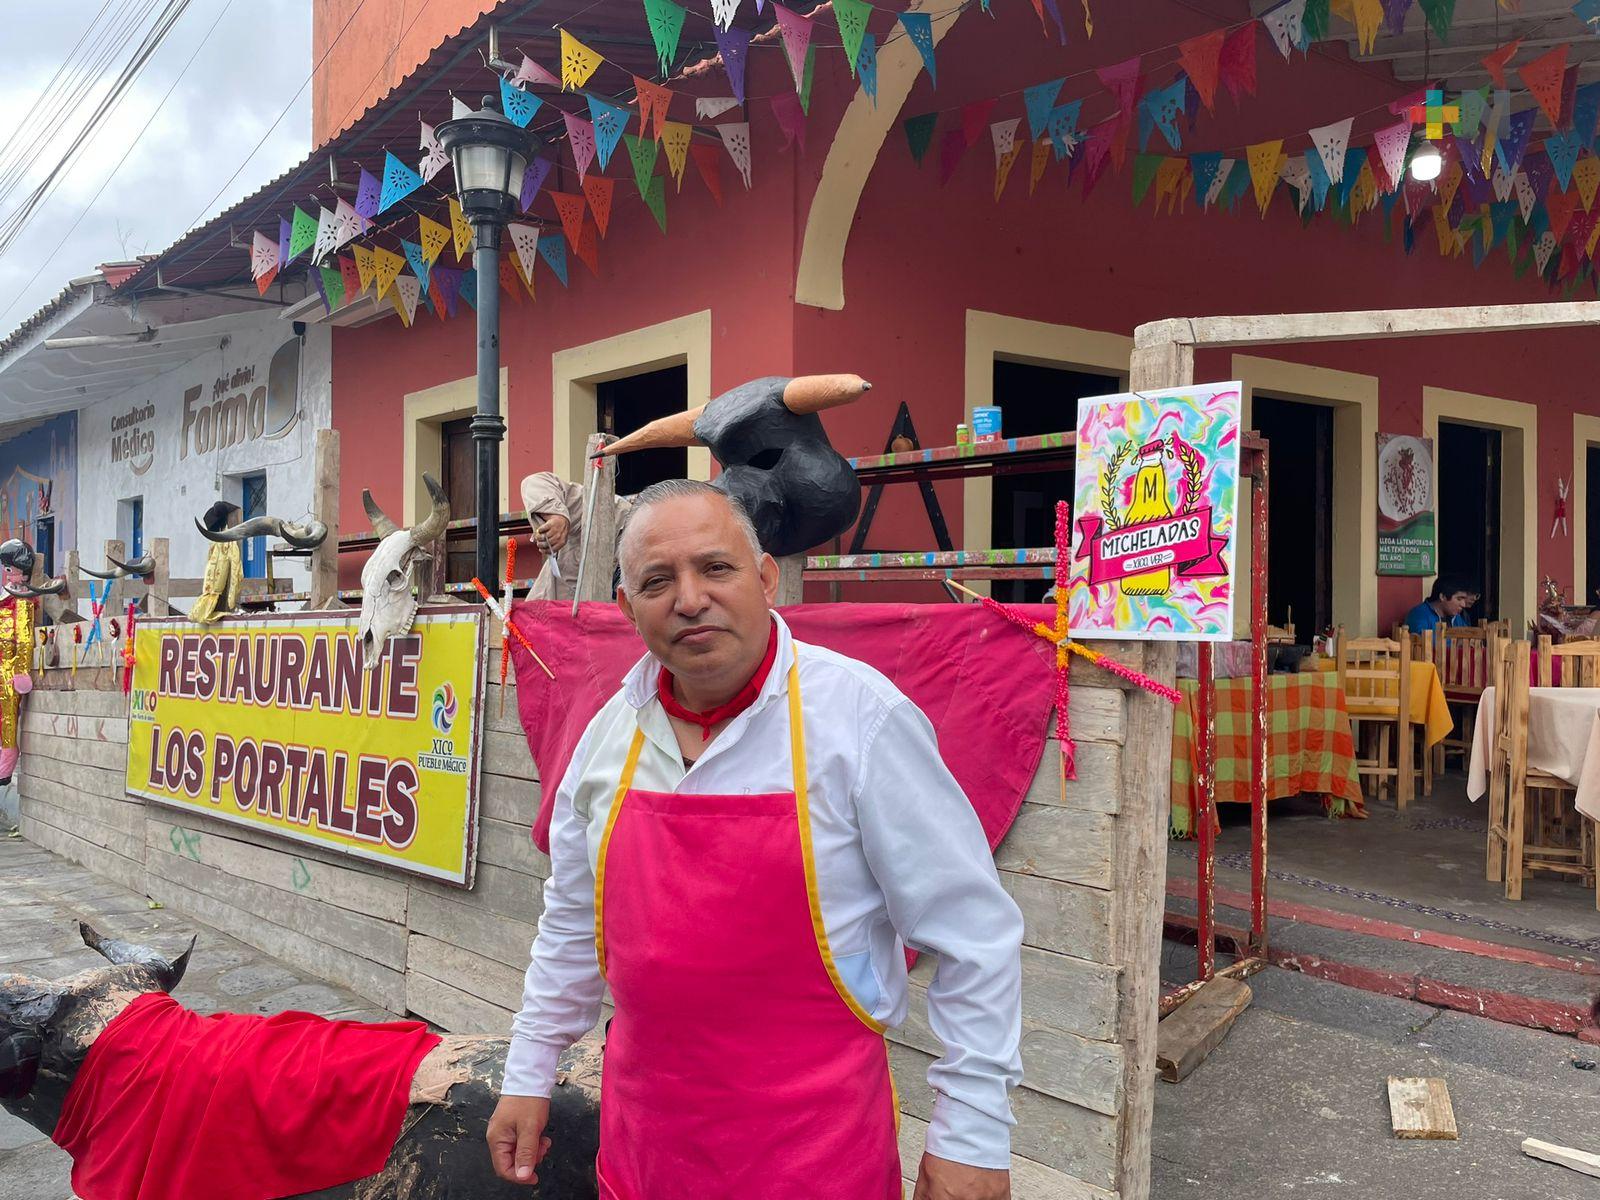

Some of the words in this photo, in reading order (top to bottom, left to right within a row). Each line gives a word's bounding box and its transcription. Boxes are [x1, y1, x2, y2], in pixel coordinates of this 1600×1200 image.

[111, 399, 155, 432] Consultorio
[111, 428, 155, 463] Médico
[1143, 473, 1158, 504] M
[1102, 518, 1200, 558] MICHELADAS
[159, 633, 421, 719] RESTAURANTE
[132, 689, 157, 712] XICO
[431, 738, 453, 756] XICO
[418, 756, 441, 770] PUEBLO
[441, 758, 467, 773] MÁGICO
[148, 724, 206, 798] LOS
[211, 732, 419, 850] PORTALES
